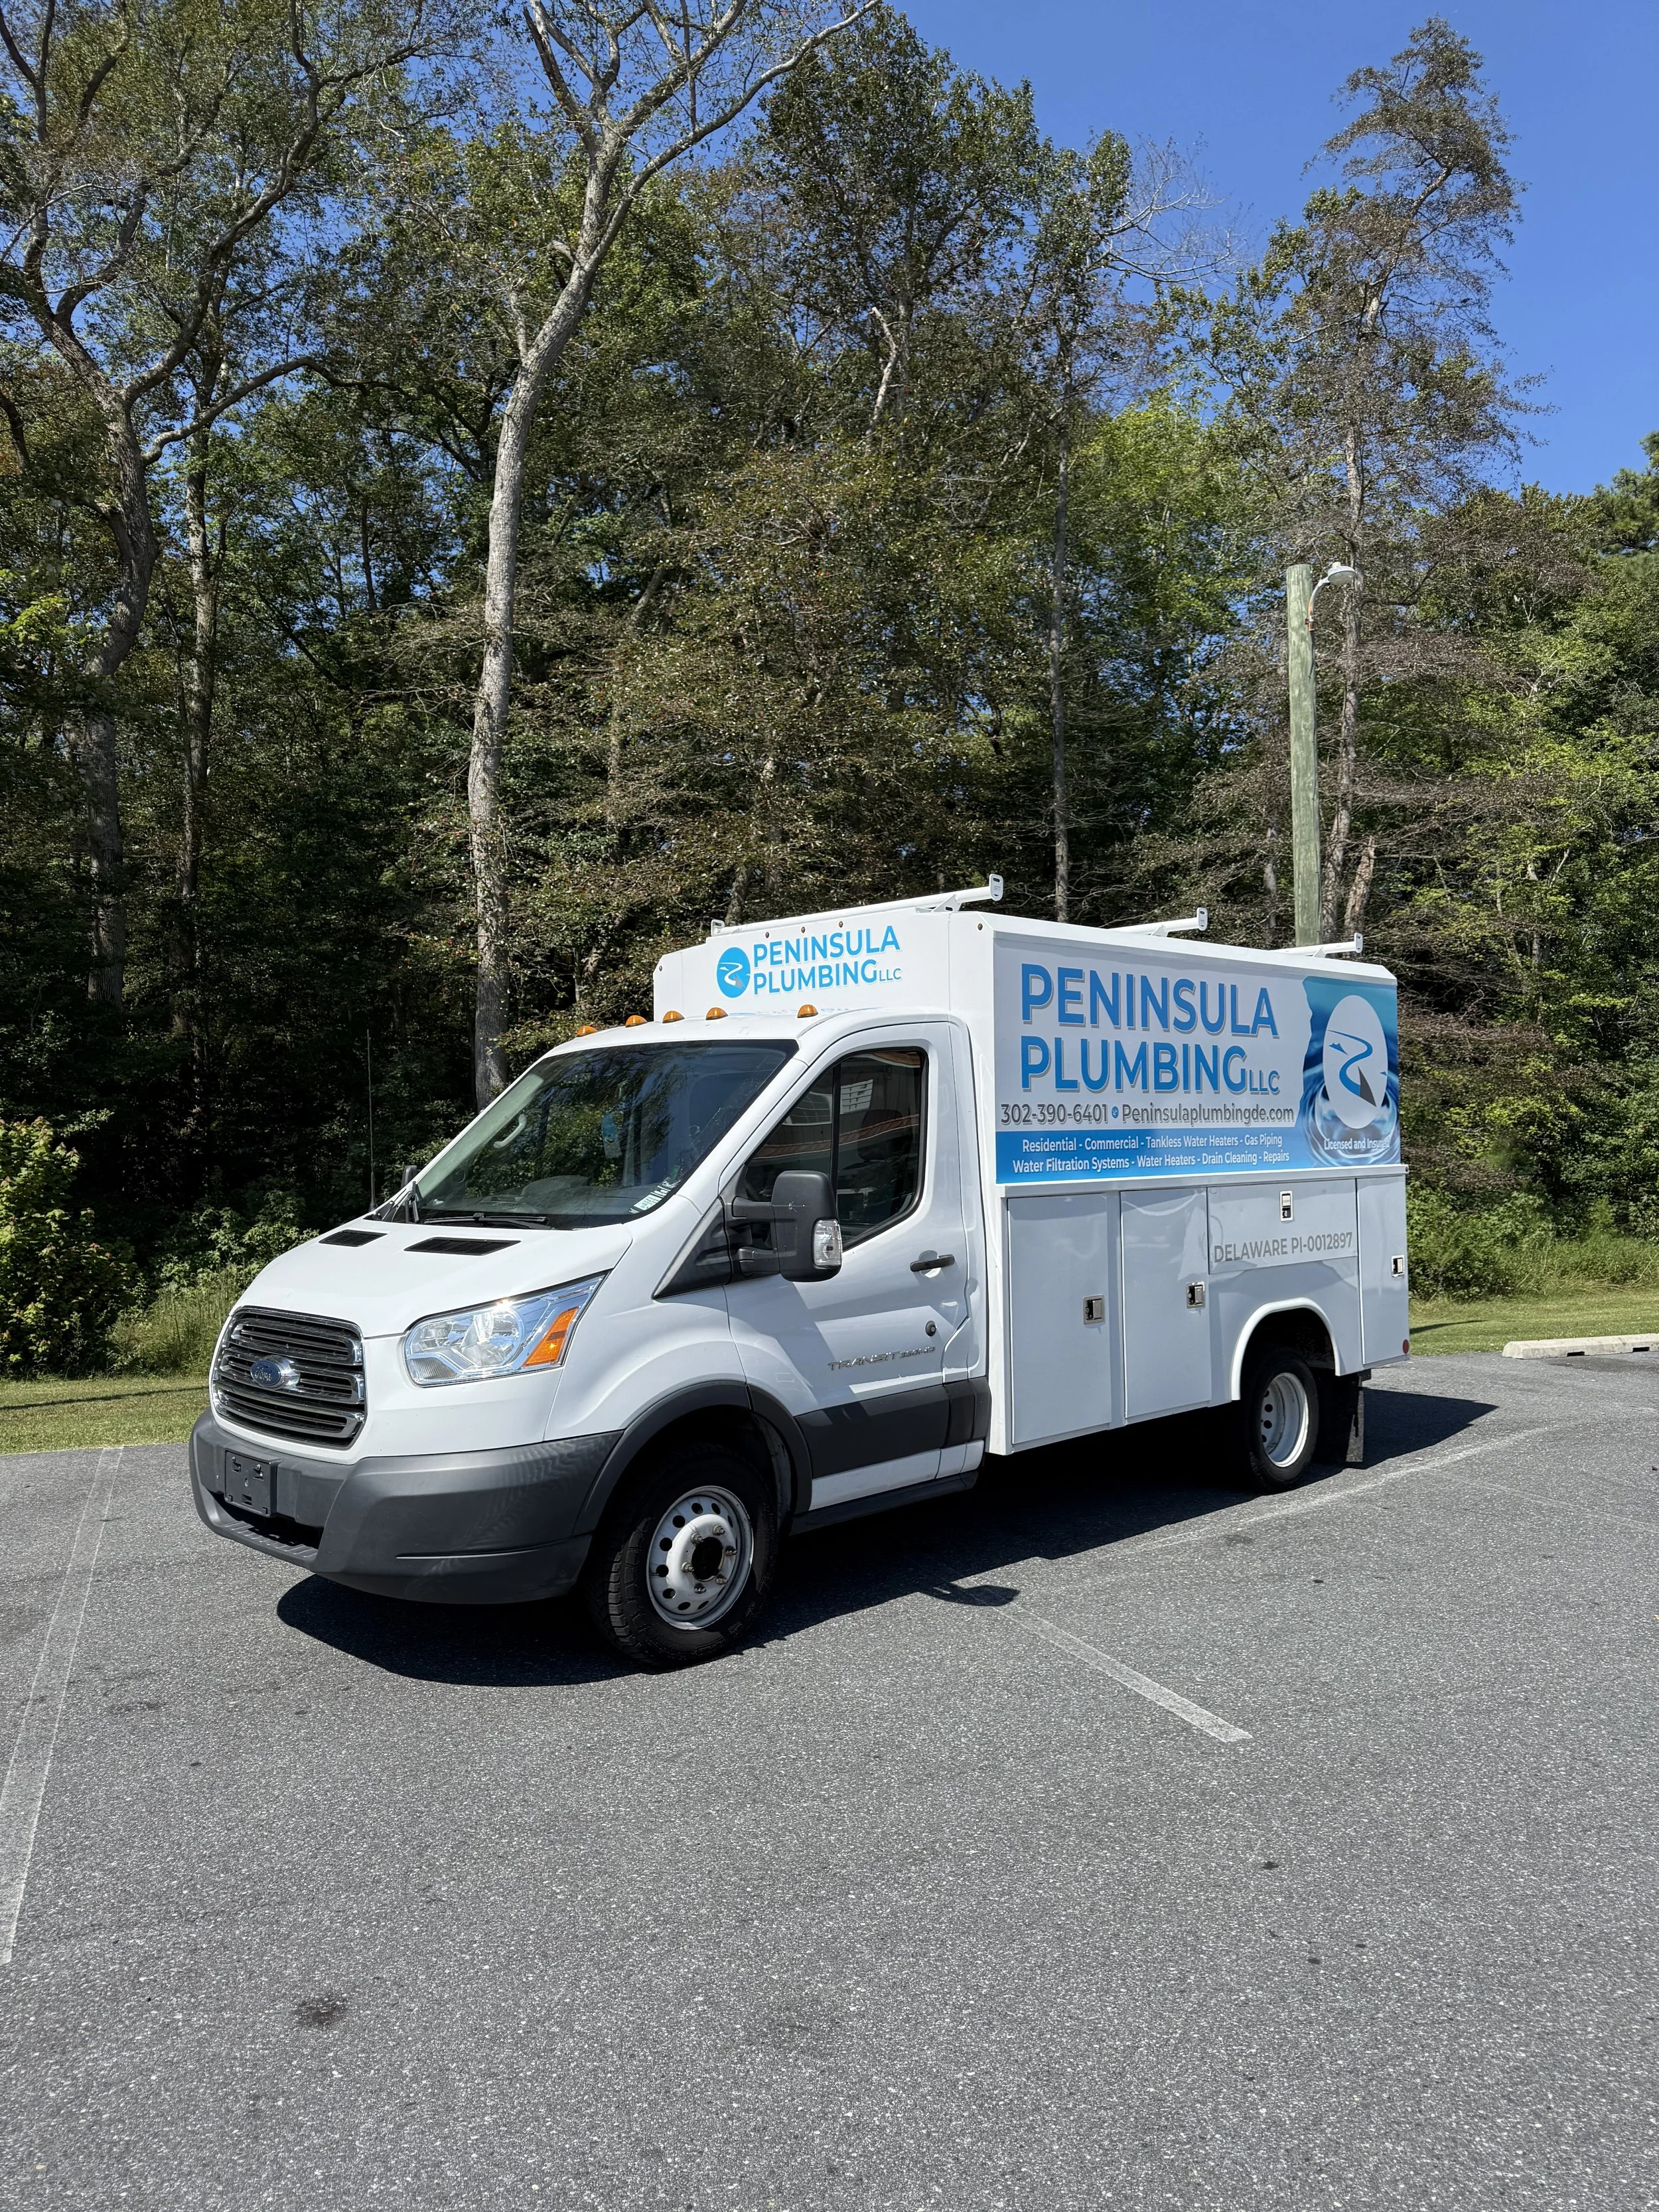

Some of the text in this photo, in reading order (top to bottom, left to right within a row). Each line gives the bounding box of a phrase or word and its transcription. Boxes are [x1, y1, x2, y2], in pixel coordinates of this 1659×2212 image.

[753, 925, 901, 968] PENINSULA
[754, 959, 902, 995] PLUMBING LLC
[1021, 964, 1279, 1039] PENINSULA
[1021, 1035, 1281, 1094] PLUMBING LLC
[1001, 1102, 1294, 1127] 302-390-6401 Peninsulaplumbingde.com
[1023, 1137, 1076, 1153] Residential
[1084, 1136, 1138, 1151] Commercial
[1145, 1135, 1182, 1149] Tankless
[1183, 1136, 1207, 1147] Water
[1209, 1134, 1238, 1147] Heaters
[1244, 1134, 1258, 1145] Gas
[1260, 1133, 1283, 1147] Piping
[1324, 1138, 1390, 1150] Licensed and Insured
[1013, 1159, 1044, 1173] Water
[1046, 1157, 1090, 1172] Filtration
[1092, 1157, 1129, 1173] Systems
[1137, 1155, 1162, 1168] Water
[1164, 1153, 1195, 1166] Heaters
[1202, 1151, 1223, 1165] Drain
[1224, 1150, 1258, 1165] Cleaning
[1263, 1149, 1289, 1163] Repairs
[1214, 1231, 1353, 1264] DELAWARE PI-0012897
[254, 1363, 273, 1382] Ford
[828, 1351, 899, 1370] TRANSIT
